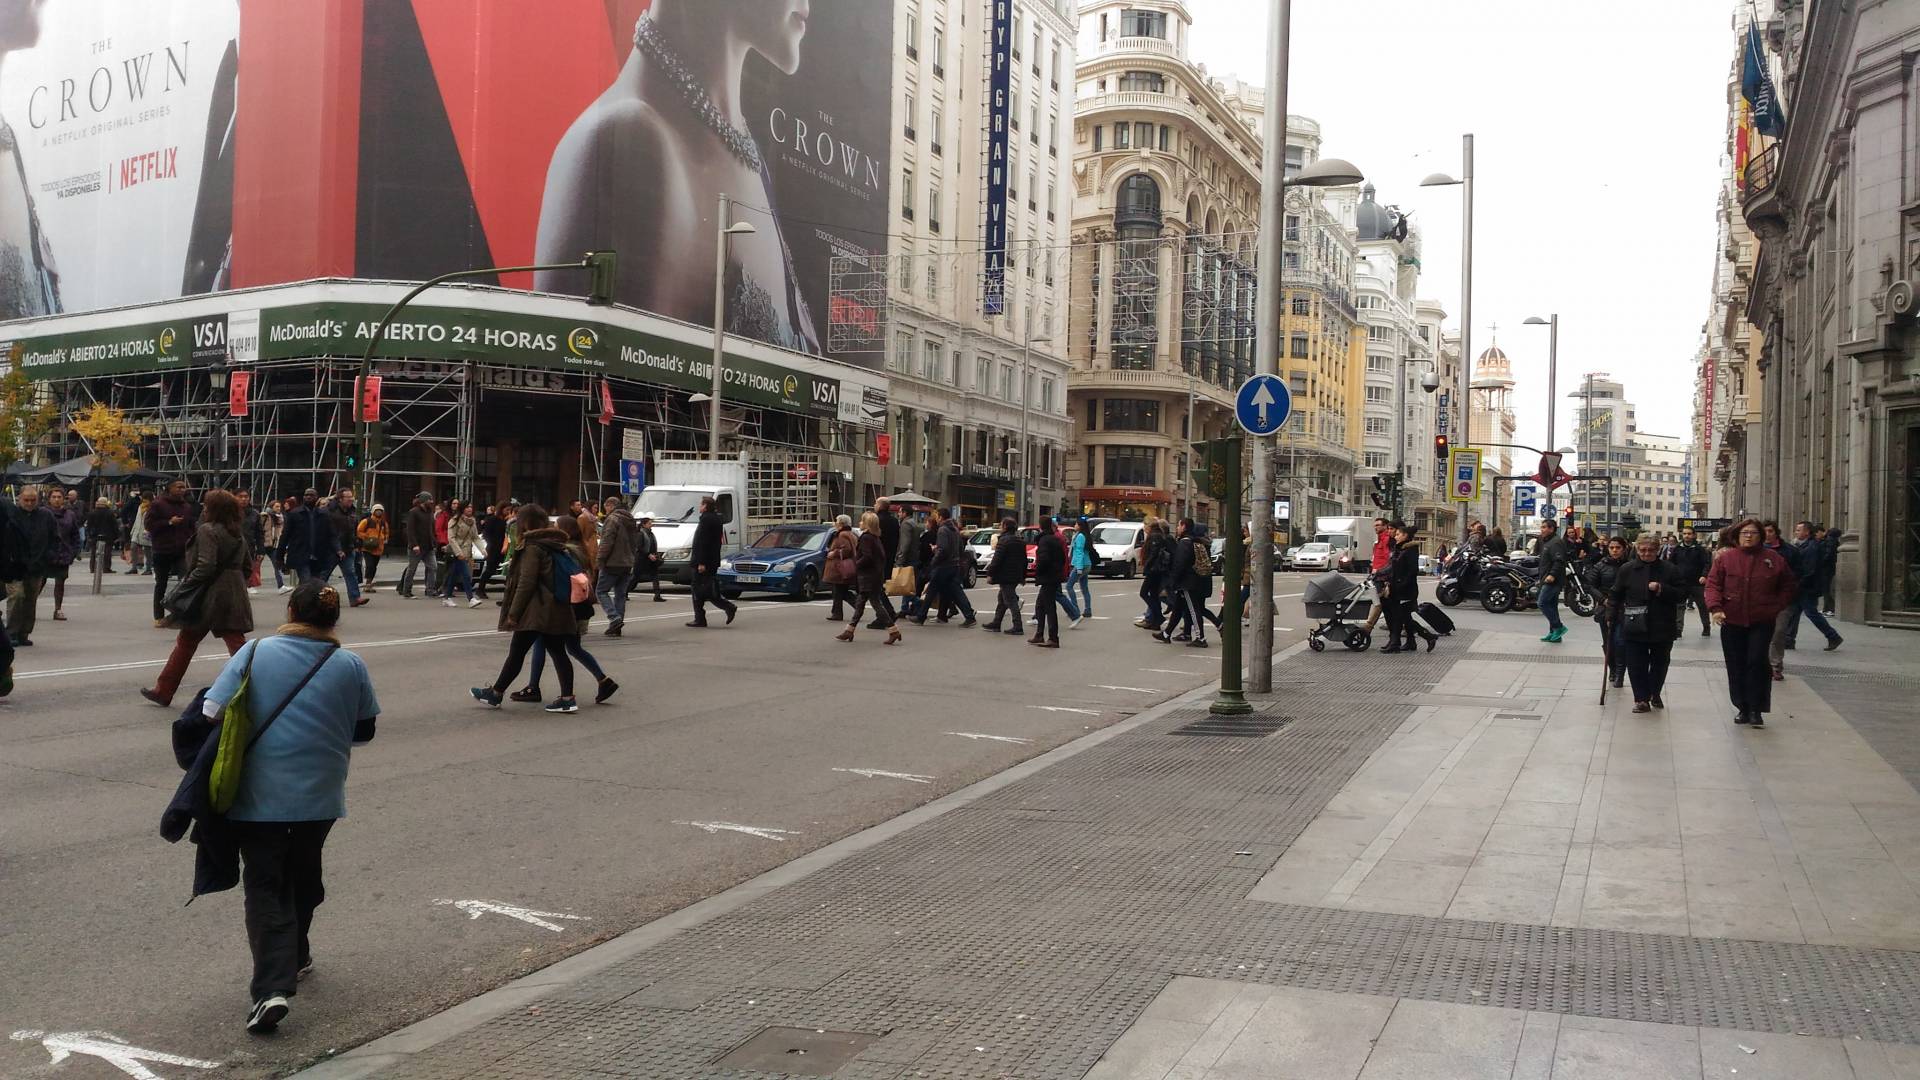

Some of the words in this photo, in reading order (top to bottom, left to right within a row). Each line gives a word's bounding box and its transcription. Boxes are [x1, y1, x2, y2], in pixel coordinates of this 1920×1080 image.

[92, 38, 112, 55] THE
[28, 40, 190, 129] CROWN
[52, 127, 87, 146] NETFLIX
[90, 117, 134, 136] ORIGINAL
[139, 105, 171, 123] SERIES
[818, 110, 833, 126] THE
[770, 107, 880, 191] CROWN
[993, 88, 1003, 185] GRAN
[120, 146, 178, 191] NETFLIX
[789, 156, 816, 176] NETFLIX
[818, 170, 848, 191] ORIGINAL
[850, 185, 871, 201] SERIES
[57, 189, 64, 200] YA
[64, 182, 102, 198] DISPONIBLES
[815, 228, 834, 244] TODOS
[830, 244, 838, 255] YA
[193, 321, 225, 348] VSA
[269, 319, 343, 343] McDonald's
[451, 326, 478, 344] 24
[484, 328, 557, 351] HORAS
[22, 348, 67, 367] McDonald's
[69, 344, 106, 362] ABIERTO
[107, 341, 119, 359] 24
[121, 339, 155, 357] HORAS
[563, 356, 583, 364] Todos
[620, 345, 684, 373] McDonald's
[688, 360, 734, 383] ABIETO
[734, 368, 747, 387] 24
[748, 373, 780, 394] HORAS
[812, 380, 837, 405] VSA
[1517, 488, 1532, 507] P
